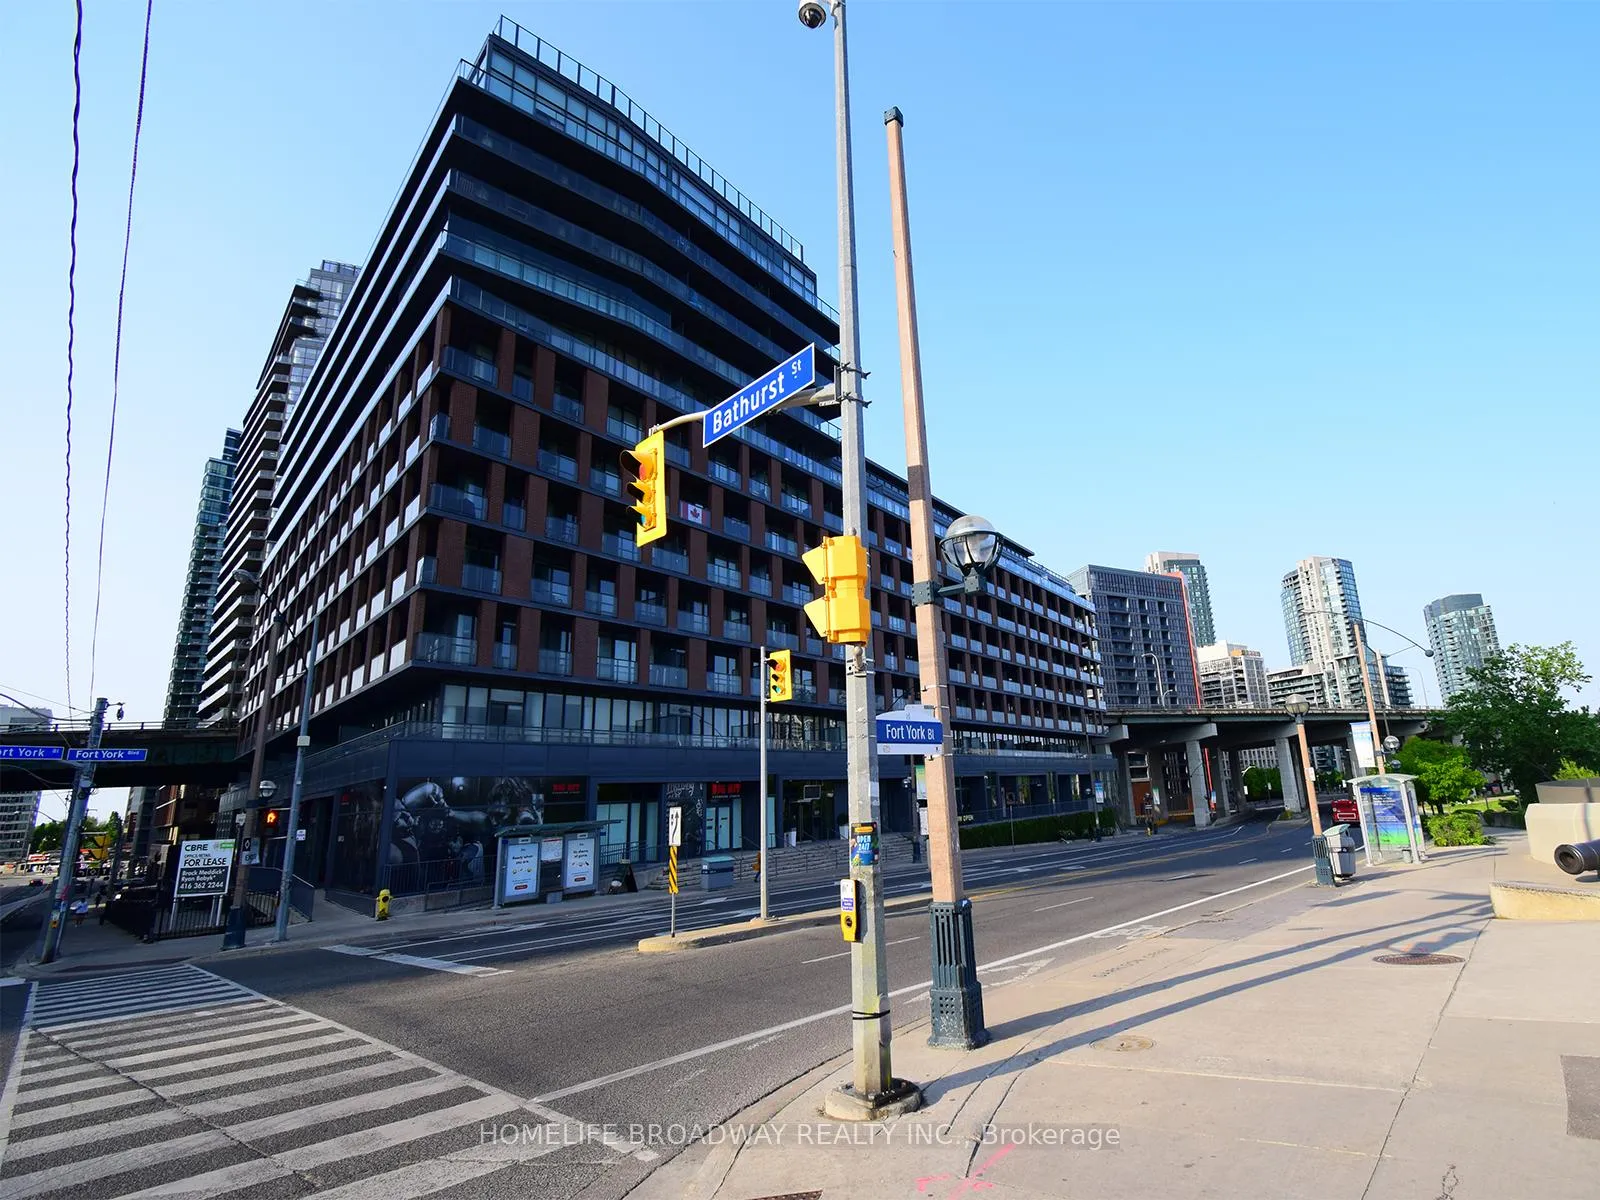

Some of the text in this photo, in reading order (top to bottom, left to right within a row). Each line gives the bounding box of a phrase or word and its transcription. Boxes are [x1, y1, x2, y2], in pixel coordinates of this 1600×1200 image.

[713, 359, 802, 434] Bathurst St
[885, 723, 905, 740] Fort
[905, 724, 926, 740] York
[18, 747, 45, 757] York
[75, 750, 99, 759] Fort
[101, 750, 124, 759] York
[856, 835, 872, 843] OPEN
[184, 843, 209, 852] CBRE
[183, 857, 227, 867] FOR LEASE
